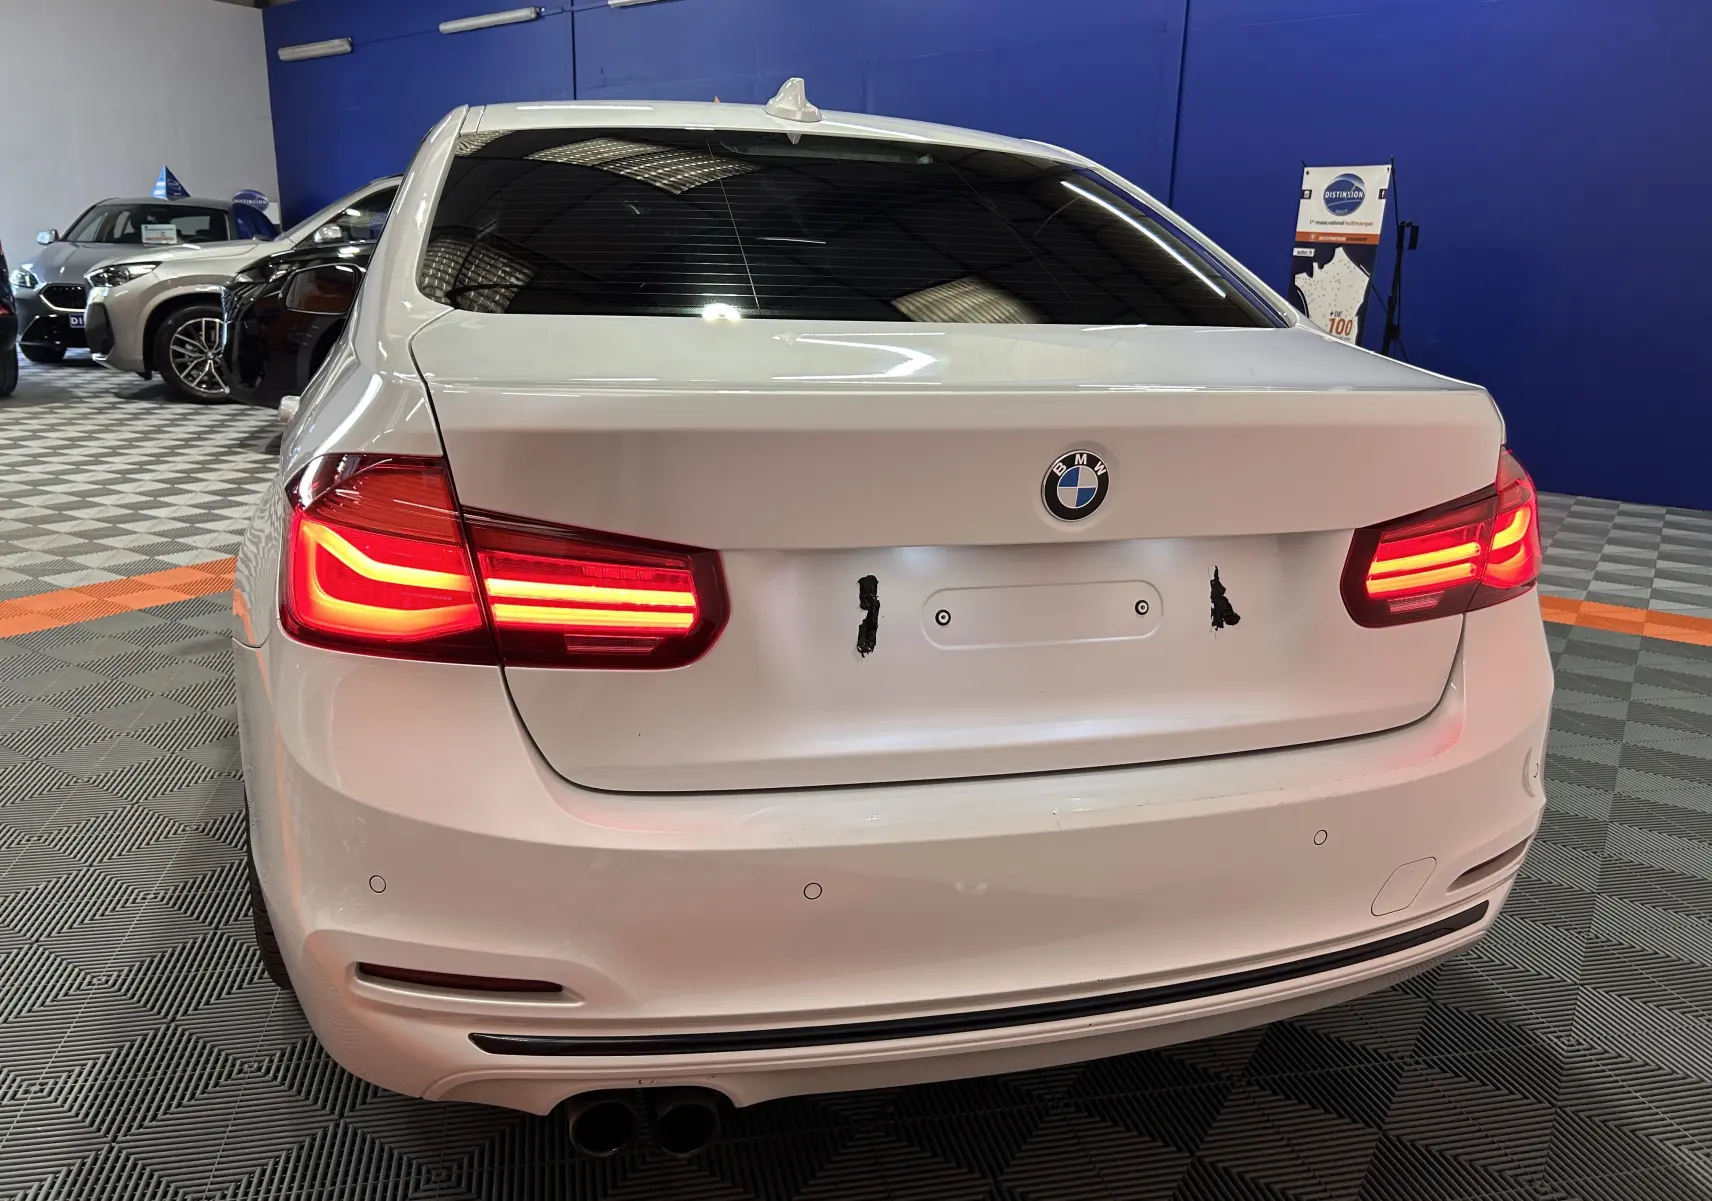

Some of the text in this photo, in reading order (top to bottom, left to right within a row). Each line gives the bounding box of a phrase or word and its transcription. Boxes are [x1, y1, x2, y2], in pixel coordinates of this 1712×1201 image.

[1324, 190, 1364, 199] DISTINXION
[1329, 317, 1353, 336] 100
[1052, 453, 1107, 477] BMW
